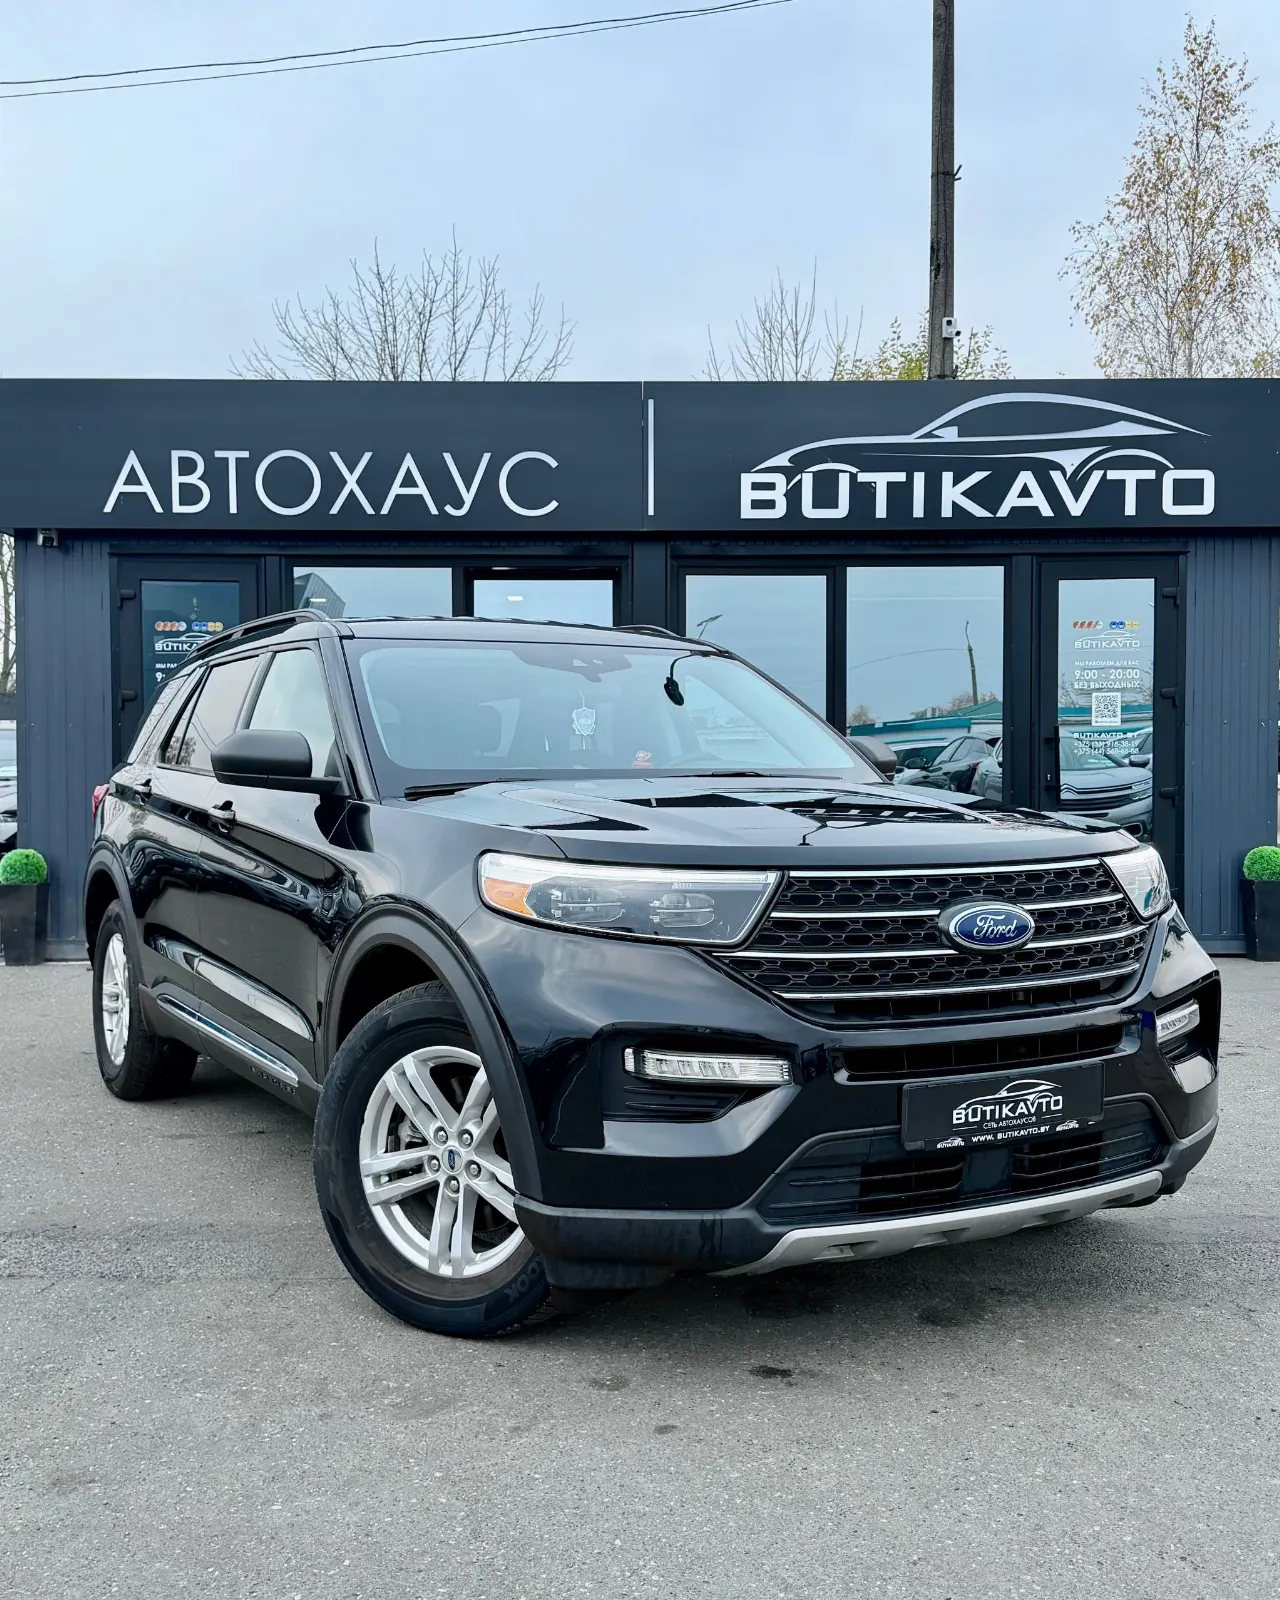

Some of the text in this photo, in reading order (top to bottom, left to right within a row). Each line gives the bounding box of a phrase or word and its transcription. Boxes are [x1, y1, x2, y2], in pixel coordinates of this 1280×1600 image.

[103, 449, 560, 517] АВТОХАУС
[740, 466, 1216, 520] BUTIKAVTO
[1074, 640, 1140, 649] BUTIKAVTO
[1074, 669, 1098, 679] 9:00
[1109, 668, 1140, 679] 20:00
[1074, 680, 1140, 689] БЕЗ ВЫХОДНЫХ
[1091, 747, 1105, 755] (44)
[973, 914, 1018, 939] Ford
[952, 1096, 1063, 1124] BUTIKAVTO
[982, 1115, 1037, 1130] СЕТЬ АВТОХАУСОВ
[971, 1125, 1051, 1143] WWW. BUTIKAVTO.BY
